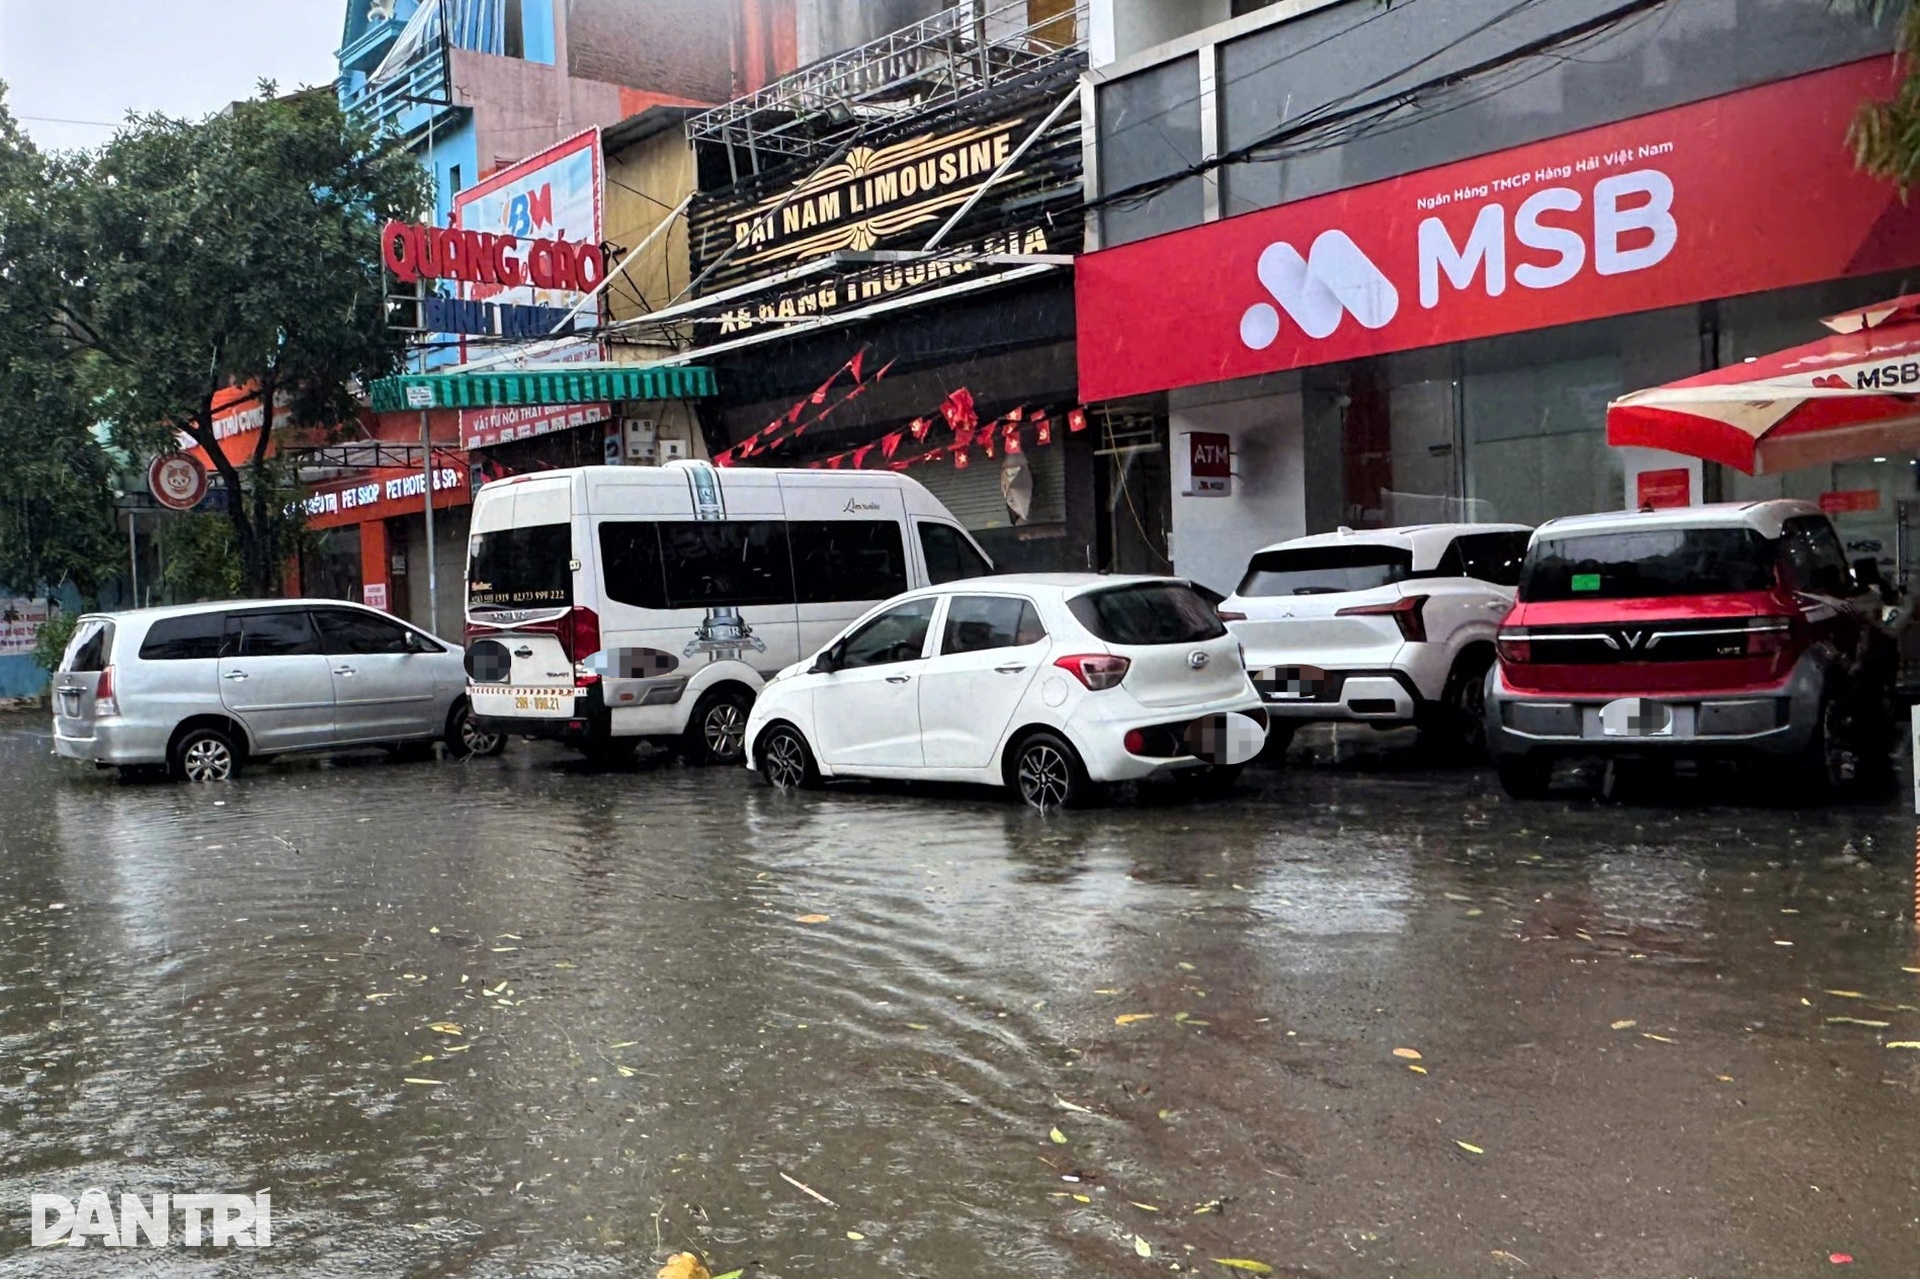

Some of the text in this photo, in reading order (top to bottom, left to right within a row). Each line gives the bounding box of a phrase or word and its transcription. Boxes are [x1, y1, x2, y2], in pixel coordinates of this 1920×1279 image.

[783, 191, 840, 234] NAM
[850, 132, 1010, 213] LIMOUSINE
[1491, 172, 1531, 192] TMCP
[1603, 149, 1634, 166] Việt
[1638, 141, 1673, 158] Nam
[529, 229, 603, 294] CÁO
[1417, 169, 1678, 309] MSB
[720, 307, 752, 334] XE
[1857, 362, 1920, 390] MSB
[1194, 444, 1229, 464] ATM
[341, 488, 357, 509] PET
[358, 483, 379, 505] SHOP
[386, 479, 401, 500] PET
[403, 473, 428, 496] HOTE
[432, 469, 441, 490] &
